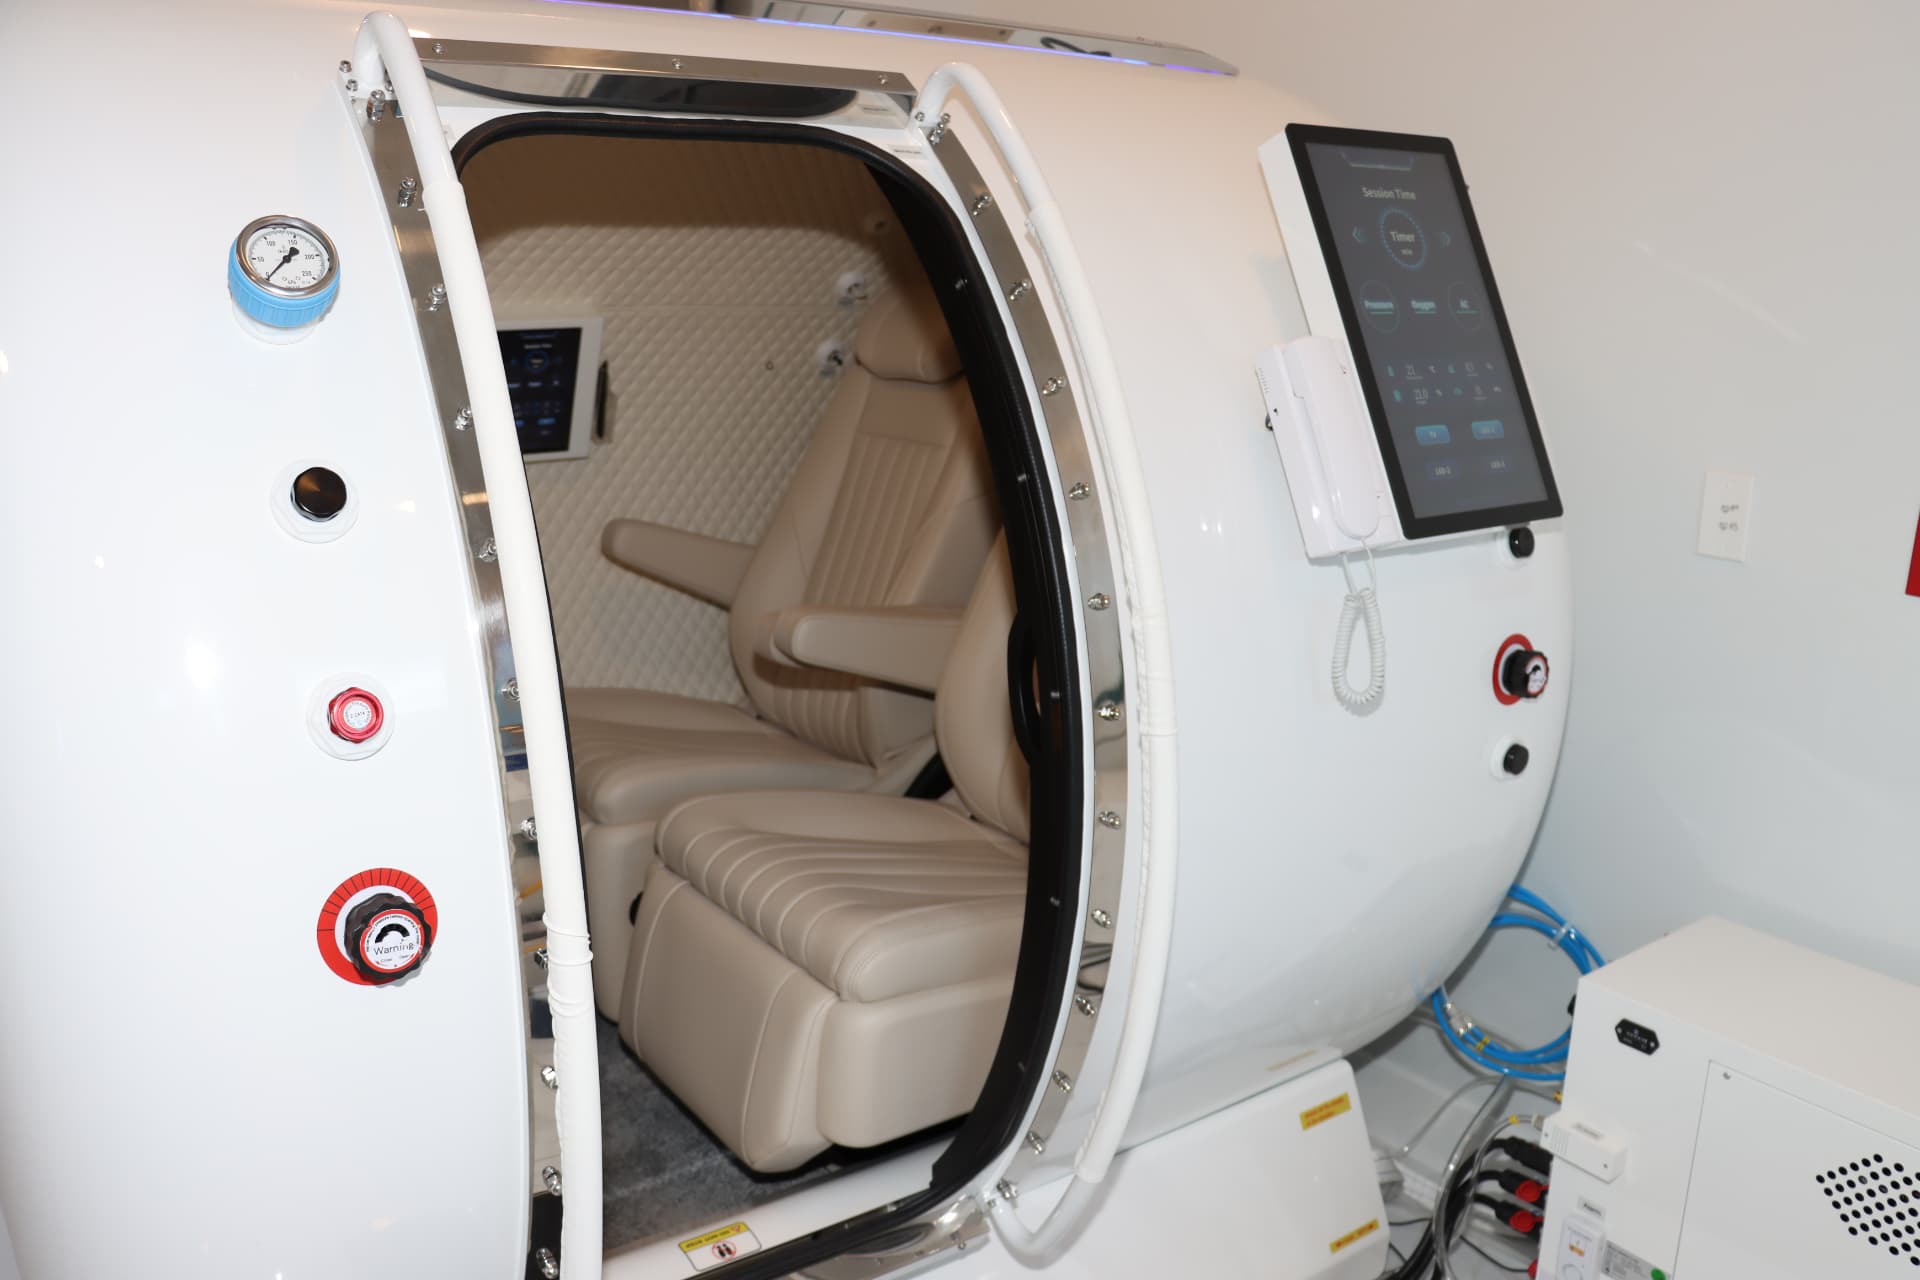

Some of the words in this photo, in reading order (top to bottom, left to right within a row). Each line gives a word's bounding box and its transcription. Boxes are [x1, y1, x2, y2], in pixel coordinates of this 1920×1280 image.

[1361, 187, 1395, 199] Session
[1396, 188, 1417, 201] Time
[1389, 231, 1416, 243] Timer
[374, 943, 414, 955] Warning
